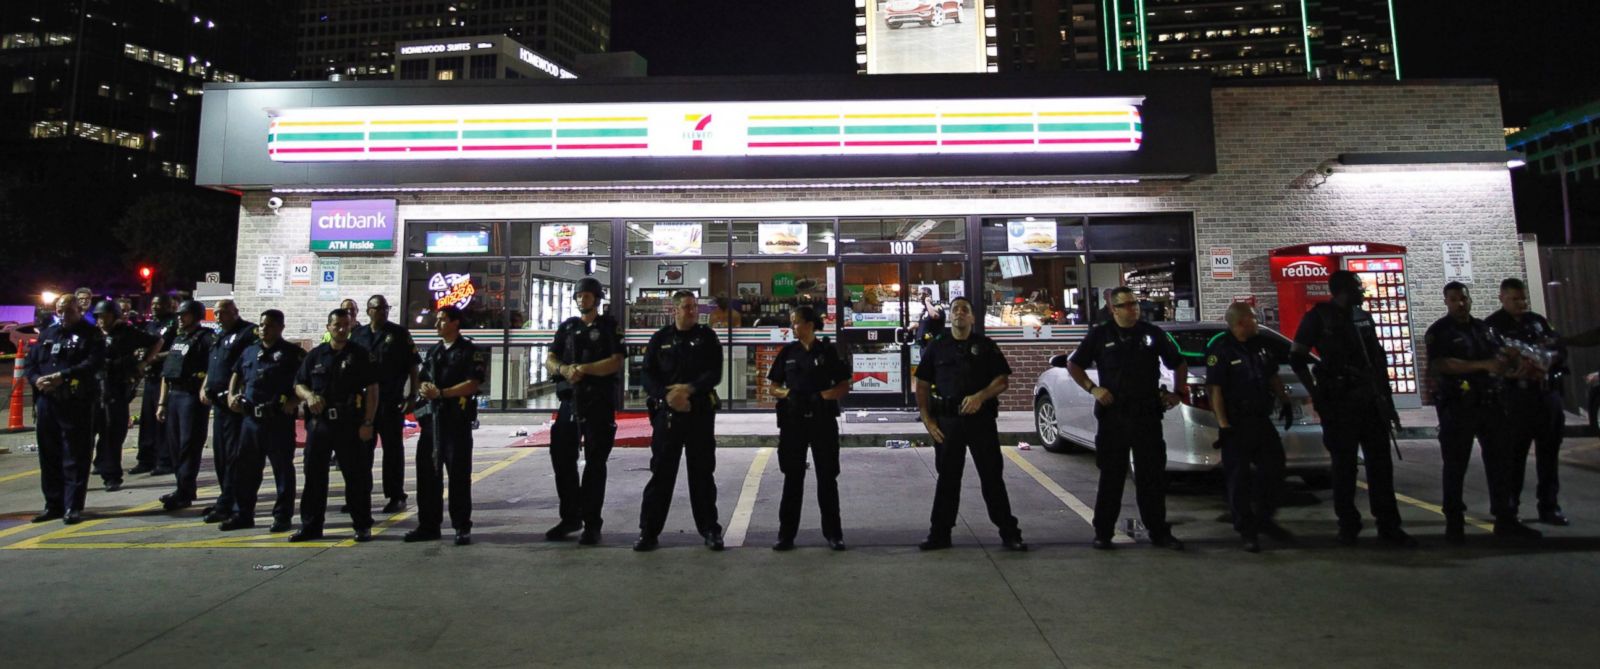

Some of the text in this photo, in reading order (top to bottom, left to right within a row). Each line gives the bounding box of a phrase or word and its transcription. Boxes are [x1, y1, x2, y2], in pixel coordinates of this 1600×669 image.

[401, 43, 471, 54] HOMEWOOD SUITES
[519, 47, 559, 77] HOMEWOOD
[684, 114, 712, 151] 7
[318, 210, 387, 229] citibank
[328, 240, 375, 250] ATM Inside
[889, 241, 914, 255] 1010
[1332, 244, 1367, 254] RENTALS
[1215, 257, 1229, 265] NO
[294, 265, 308, 273] NO
[1281, 265, 1329, 278] redbox
